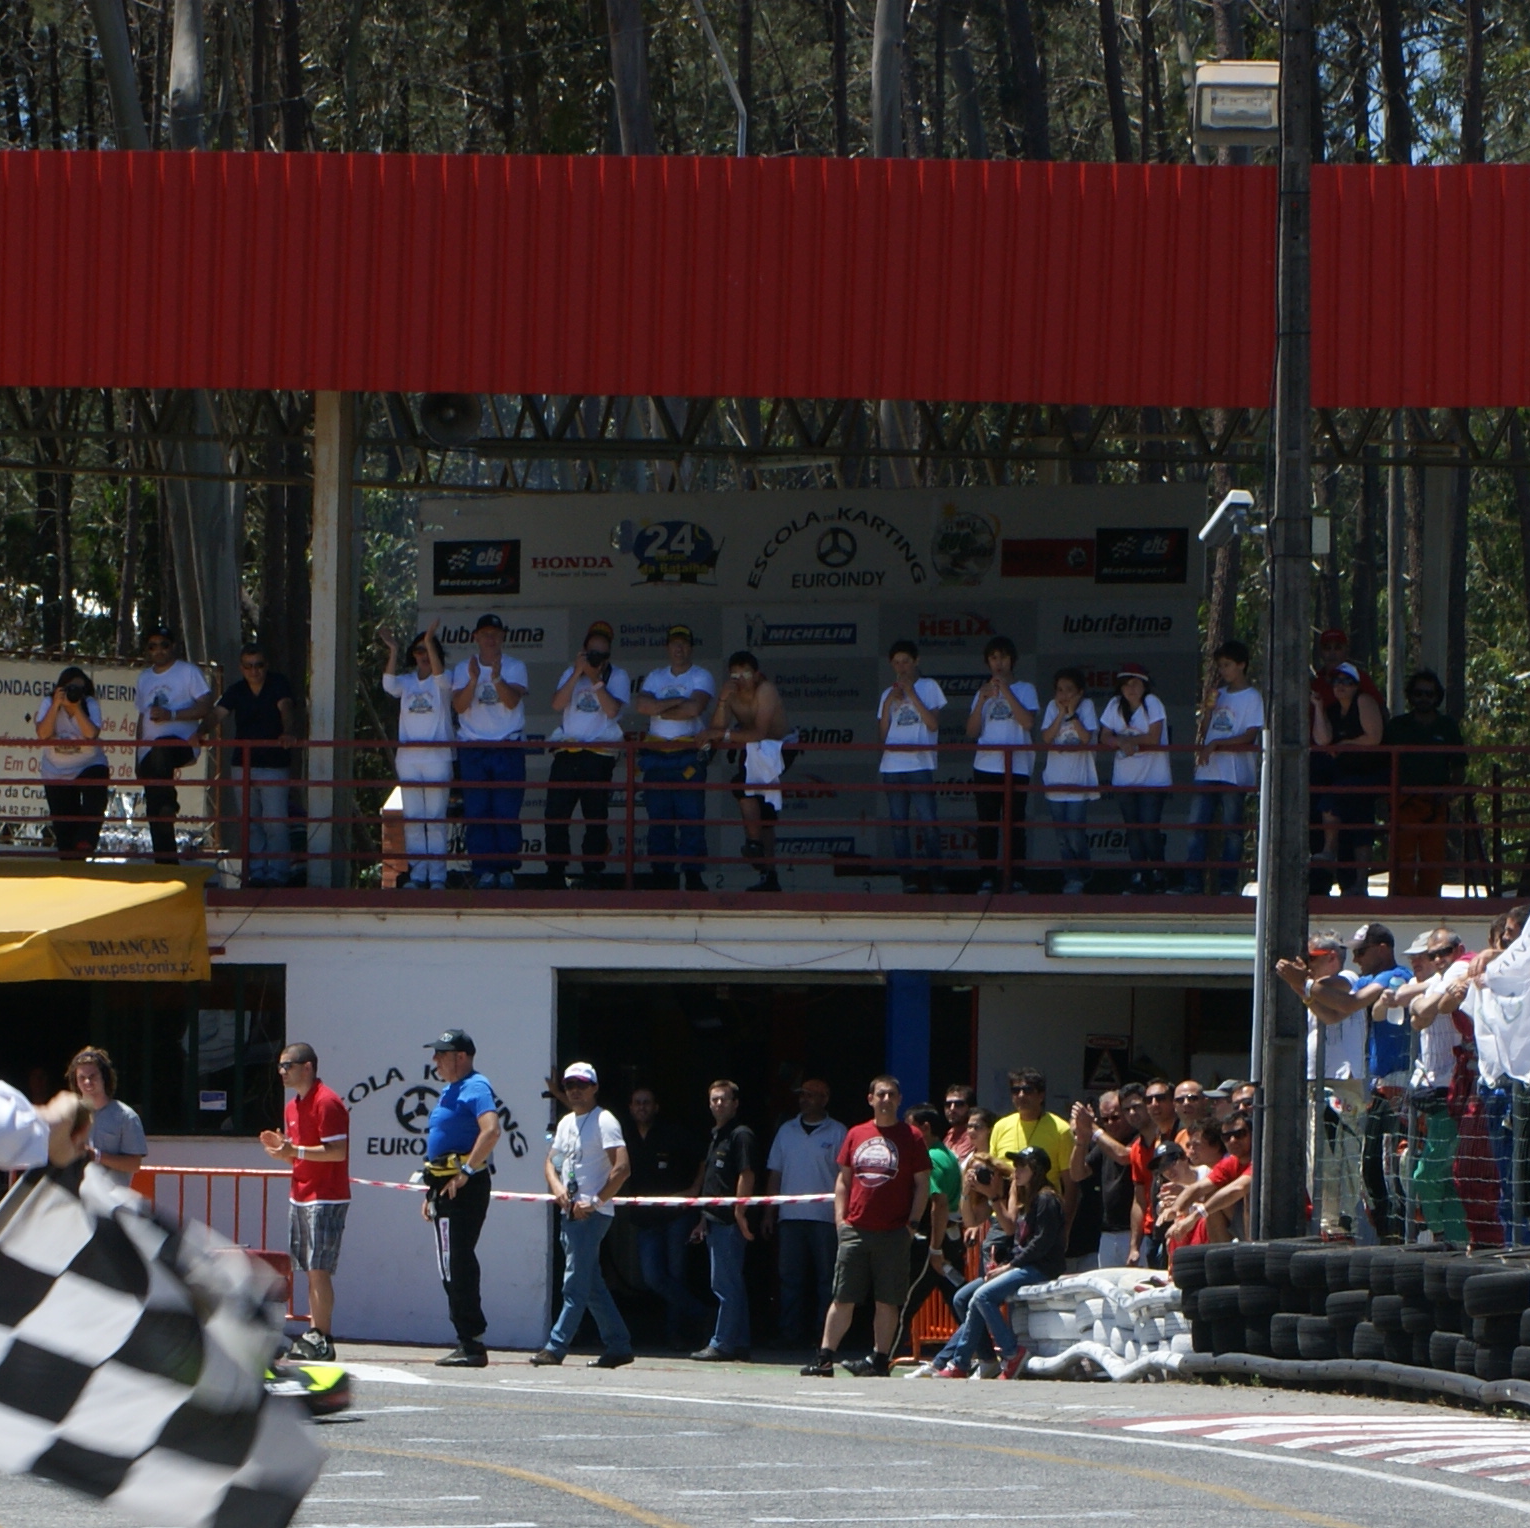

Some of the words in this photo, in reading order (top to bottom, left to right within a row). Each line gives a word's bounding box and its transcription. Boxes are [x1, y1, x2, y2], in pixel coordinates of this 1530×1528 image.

[644, 524, 696, 558] 24
[747, 511, 820, 589] ESCOLA
[837, 507, 927, 584] KARTING
[531, 556, 614, 569] HONDA
[439, 578, 502, 586] Motorsport
[791, 571, 885, 588] EUROINDY
[919, 619, 993, 636] HELIX
[1062, 613, 1173, 634] lubrifatima
[768, 626, 854, 641] MICHELIN
[101, 716, 116, 732] de
[4, 755, 24, 771] Em
[118, 763, 133, 777] de
[5, 786, 19, 798] da
[88, 938, 170, 959] BALANÇAS
